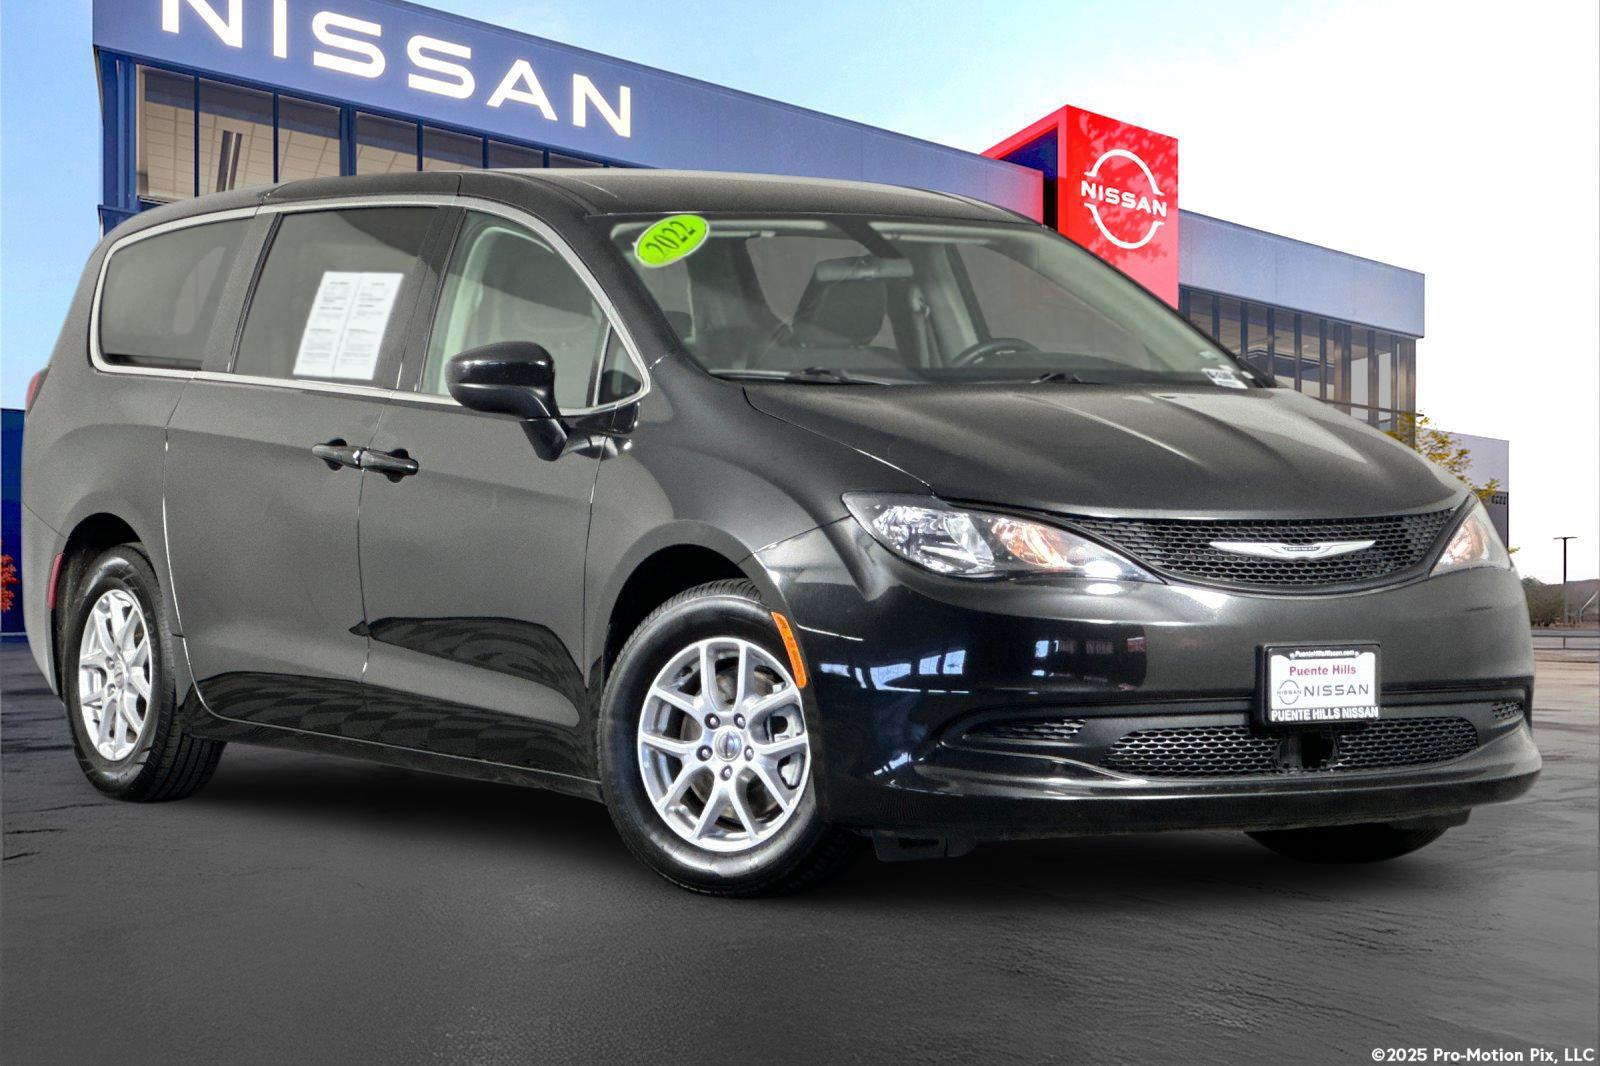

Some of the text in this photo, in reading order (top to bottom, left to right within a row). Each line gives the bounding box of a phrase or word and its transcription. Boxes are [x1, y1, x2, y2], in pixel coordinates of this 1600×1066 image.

[161, 0, 632, 139] NISSAN
[1080, 180, 1167, 217] NISSAN
[645, 220, 697, 258] 2022
[1289, 665, 1357, 676] Puente Hills
[1303, 684, 1369, 697] NISSAN
[1271, 705, 1379, 721] PUENTE HILLS NISSAN
